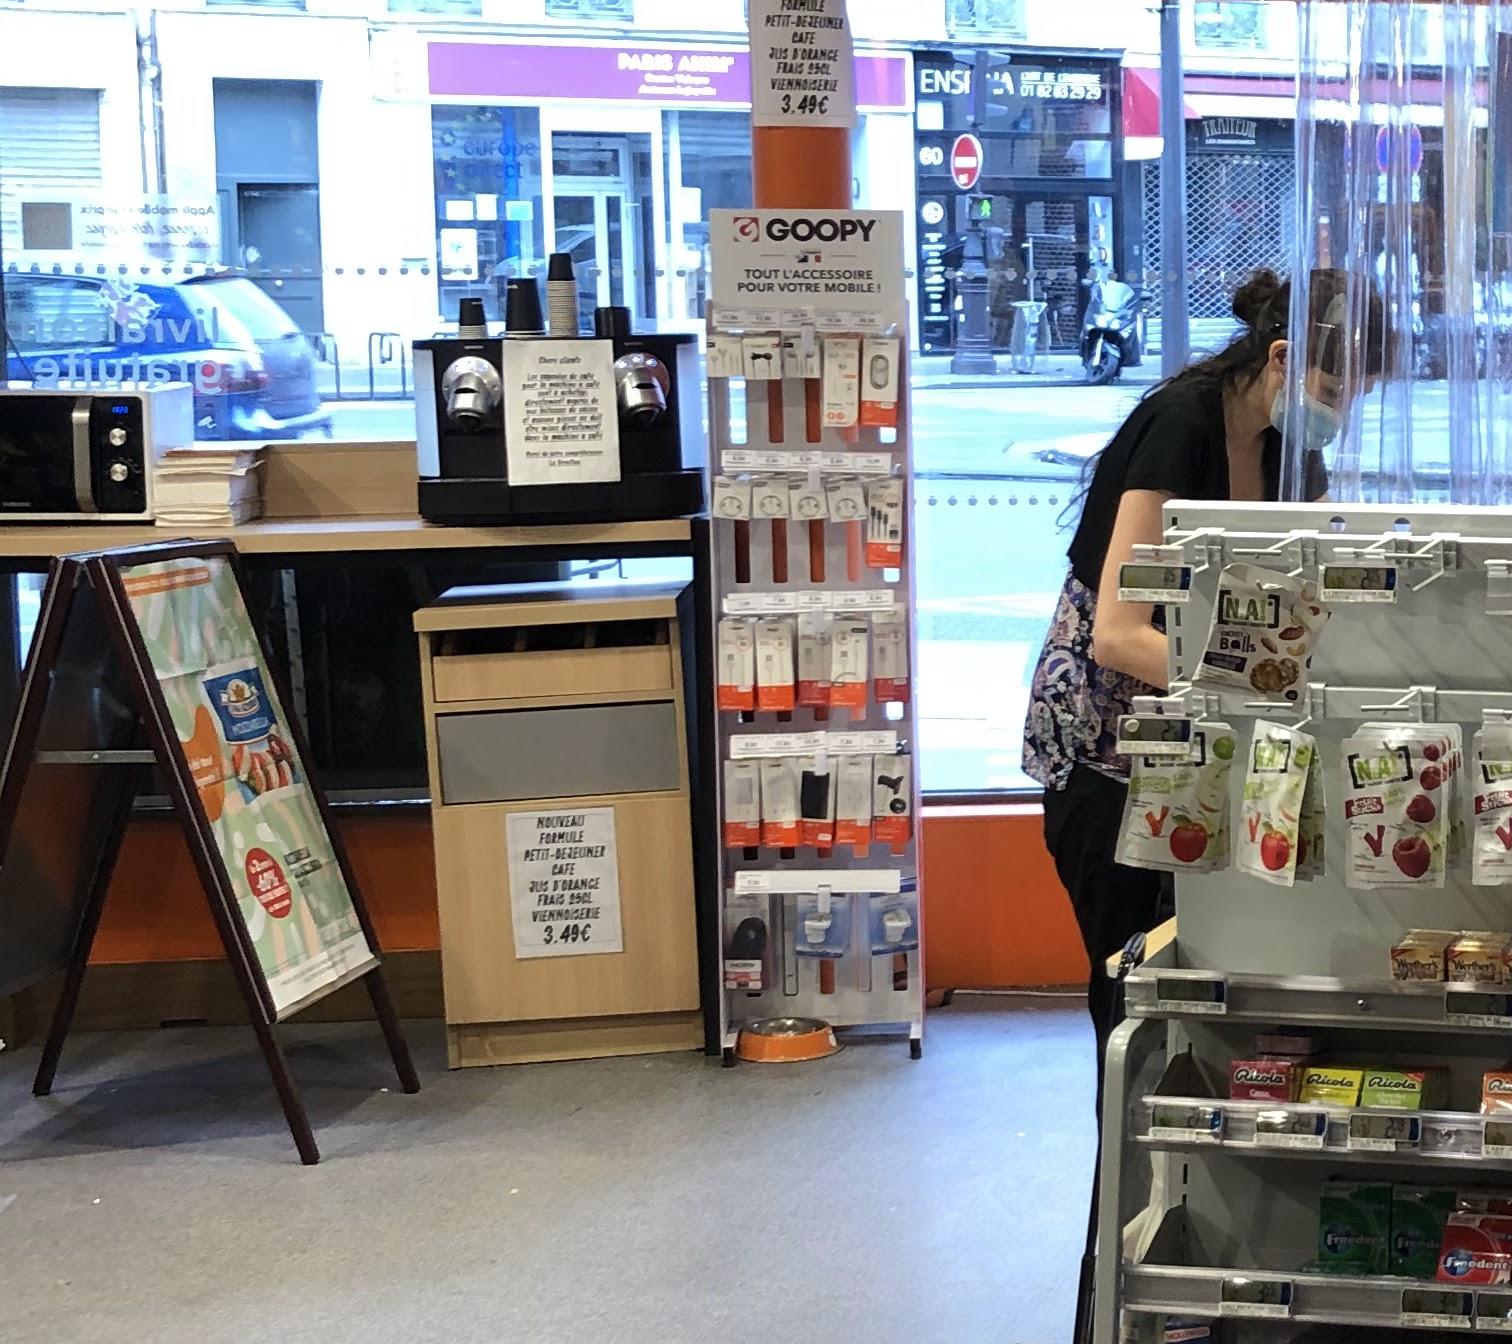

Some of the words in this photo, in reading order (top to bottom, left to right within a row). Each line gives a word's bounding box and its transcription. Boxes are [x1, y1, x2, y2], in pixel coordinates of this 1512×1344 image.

[792, 31, 816, 44] CAFE
[769, 47, 788, 59] JUS
[792, 48, 839, 62] D'ORANGE
[776, 62, 804, 74] FRAIS
[771, 78, 839, 92] VIENNOISERIE
[781, 94, 829, 114] 3.49€
[1202, 118, 1257, 138] TRAITEUR
[464, 140, 539, 157] europe
[766, 218, 876, 242] GOOPY
[744, 269, 780, 279] TOUT
[783, 269, 874, 280] L'ACCESSOIRE
[737, 282, 774, 293] POUR
[778, 282, 821, 293] VOTRE
[824, 282, 874, 293] MOBILE
[536, 815, 585, 829] NOUVEAU
[539, 830, 585, 844] FORMULE
[551, 863, 576, 876] CAFE
[529, 880, 549, 893] JUS
[552, 877, 601, 892] D'ORANGE
[537, 894, 565, 906] FRAIS
[569, 892, 593, 905] 25CL
[532, 907, 601, 922] VIENNOISERIE
[543, 923, 591, 945] 3.49€
[1234, 1067, 1286, 1085] Ricola
[1306, 1073, 1354, 1088] Ricola
[1368, 1076, 1417, 1089] Ricola
[1396, 1237, 1442, 1250] Freede
[1445, 1256, 1510, 1270] Freedent
[1166, 1327, 1210, 1341] HOLLYWOOD
